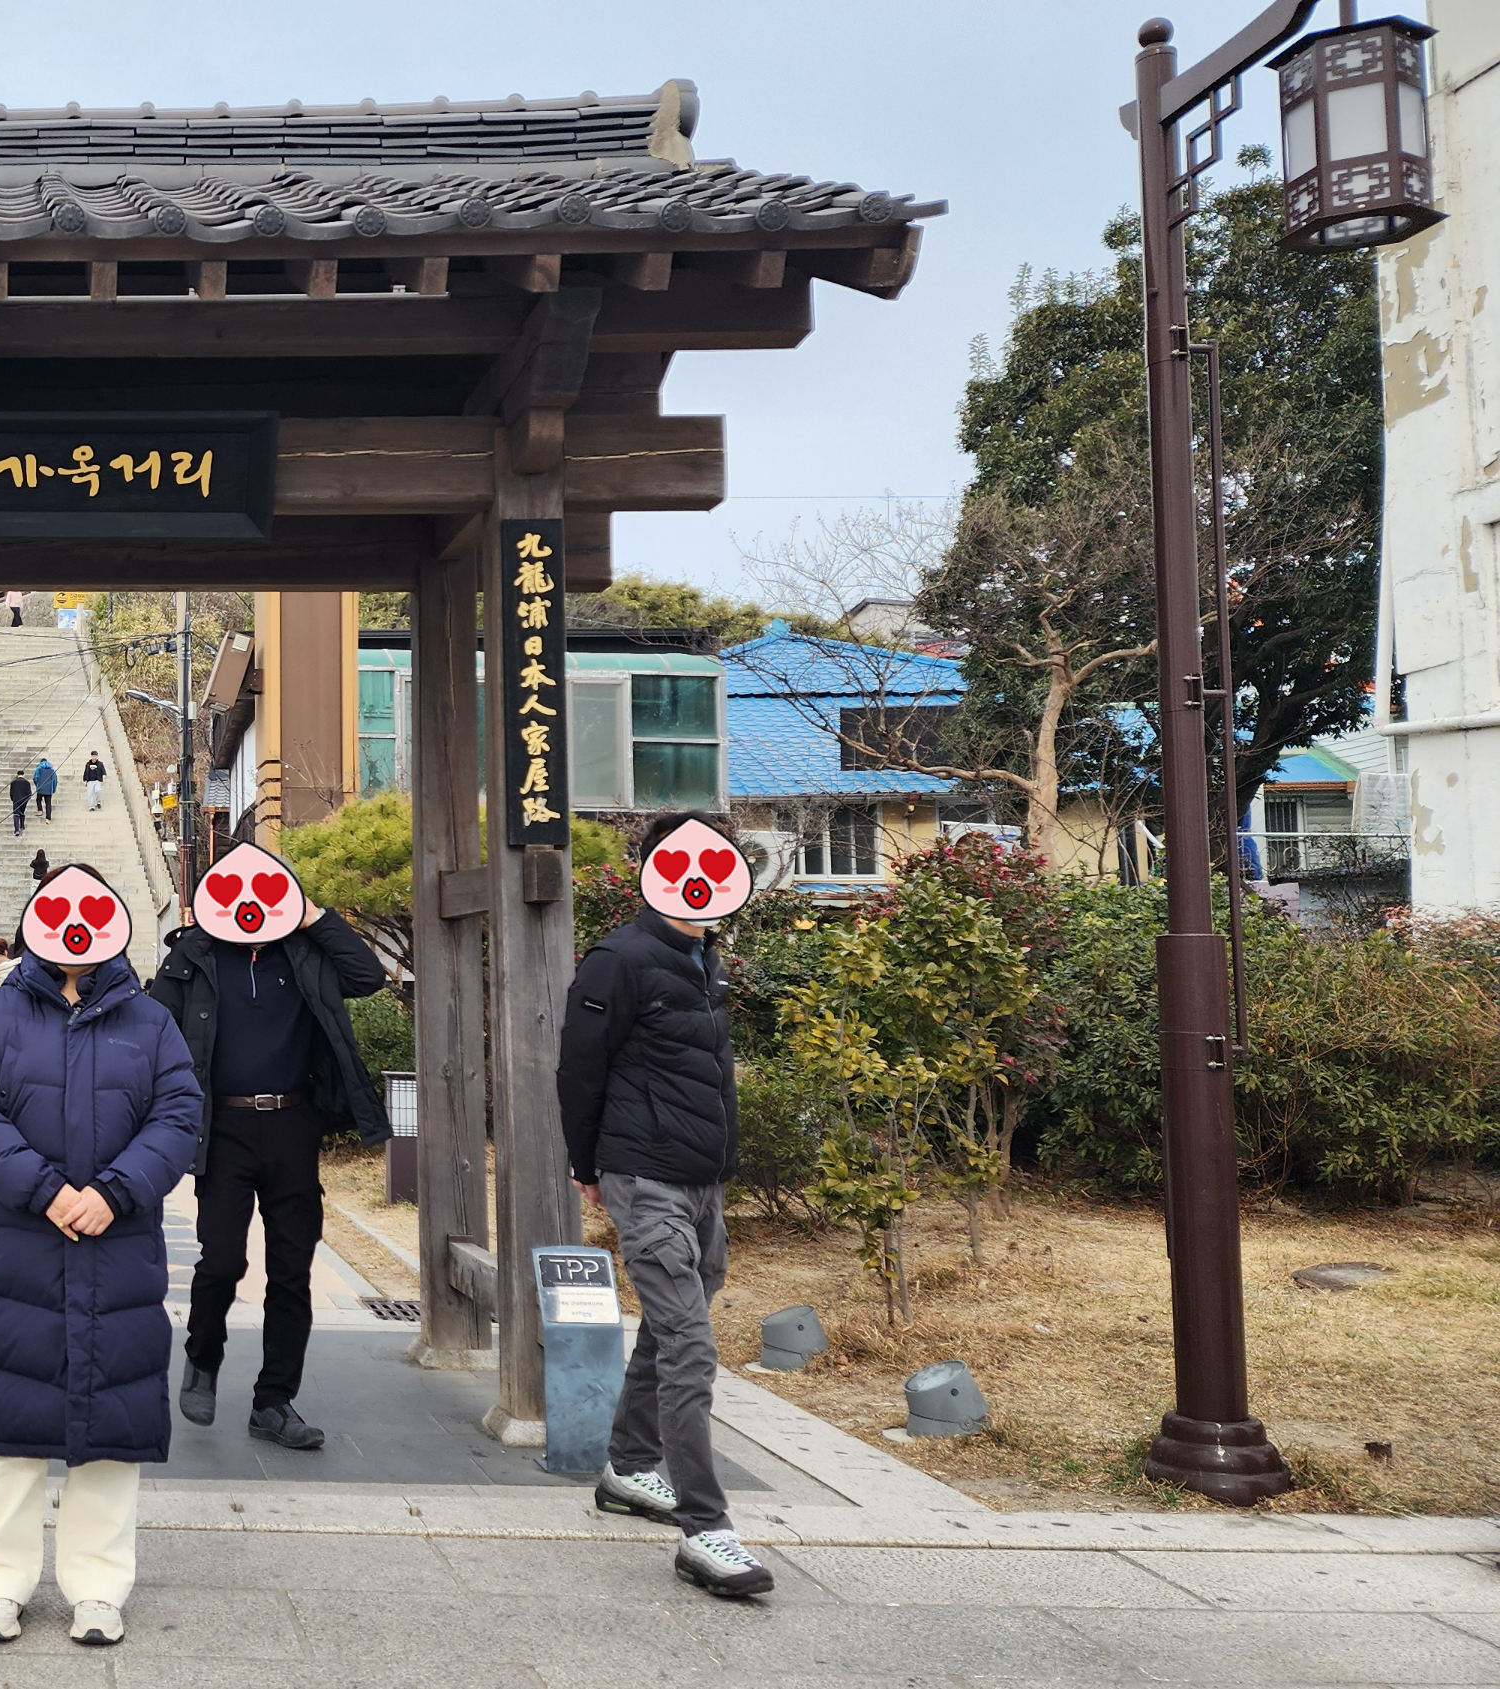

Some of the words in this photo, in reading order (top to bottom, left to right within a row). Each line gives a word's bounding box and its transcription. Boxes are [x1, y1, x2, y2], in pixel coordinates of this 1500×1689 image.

[513, 532, 561, 828] 九龍浦日本人家屋路
[548, 1258, 599, 1281] TPP
